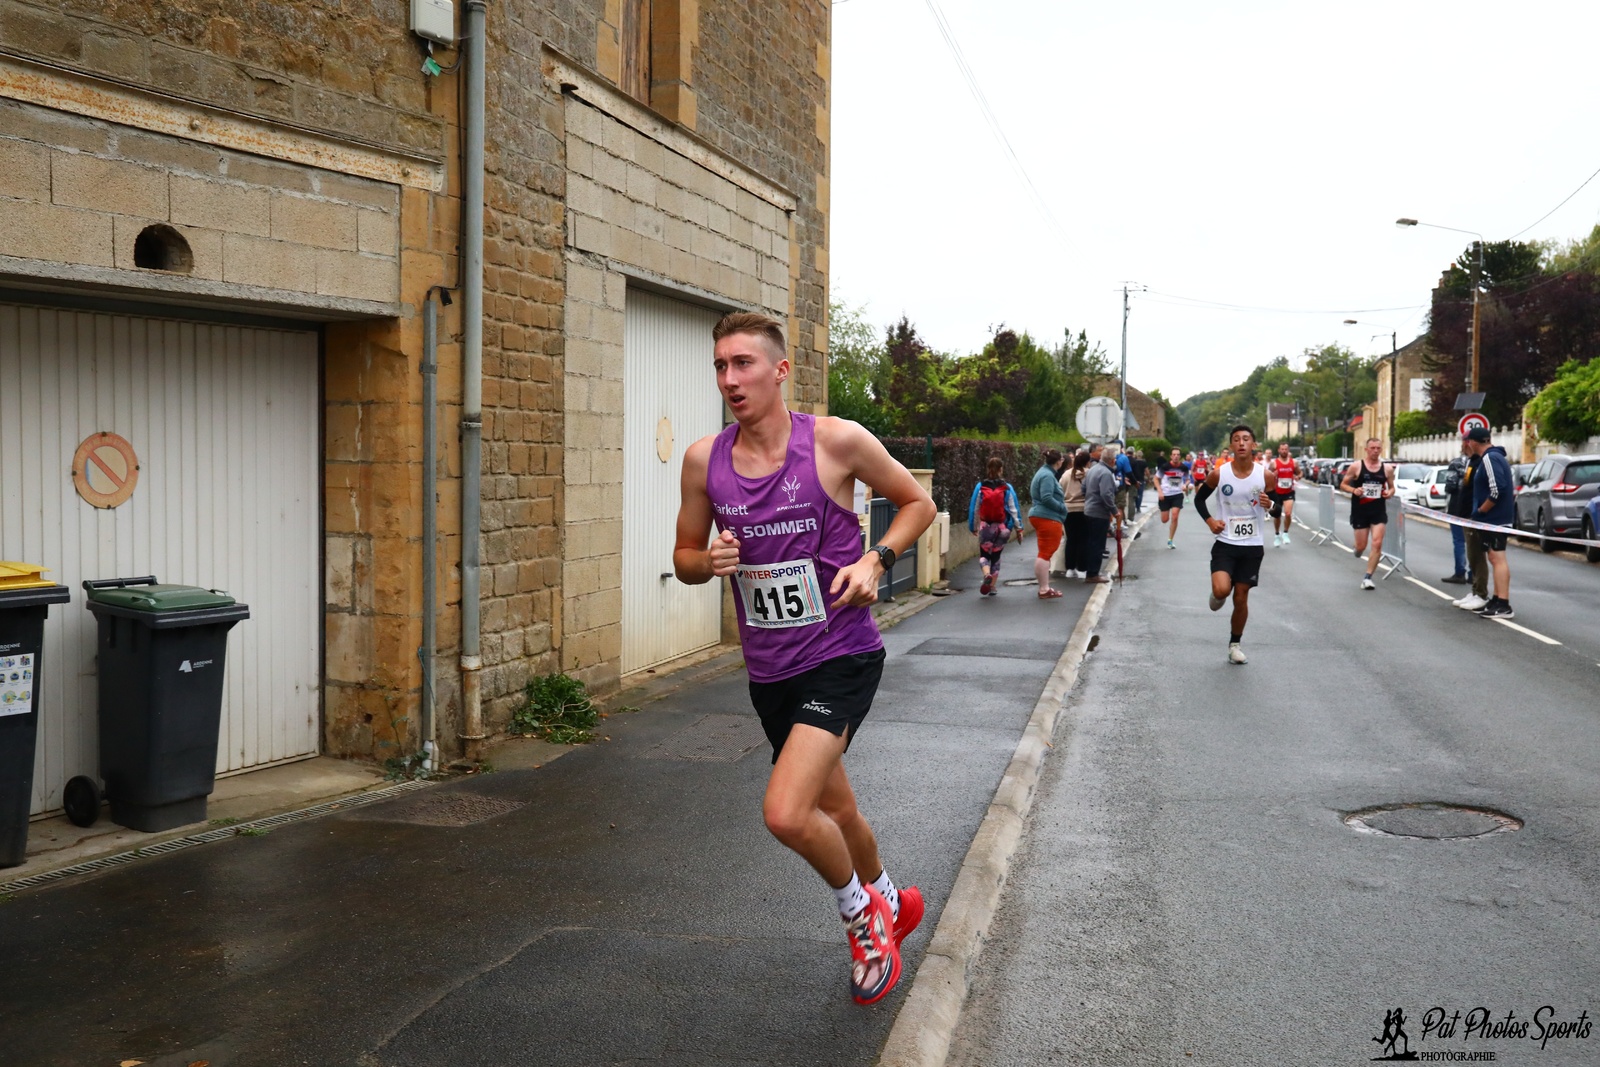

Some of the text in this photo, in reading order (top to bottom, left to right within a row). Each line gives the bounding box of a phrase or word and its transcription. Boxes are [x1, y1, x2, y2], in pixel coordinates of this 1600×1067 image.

[743, 518, 817, 538] SOMMER
[1234, 523, 1254, 536] 463
[743, 564, 807, 580] INTERSPORT
[753, 584, 805, 620] 415
[0, 642, 21, 650] RDENNE
